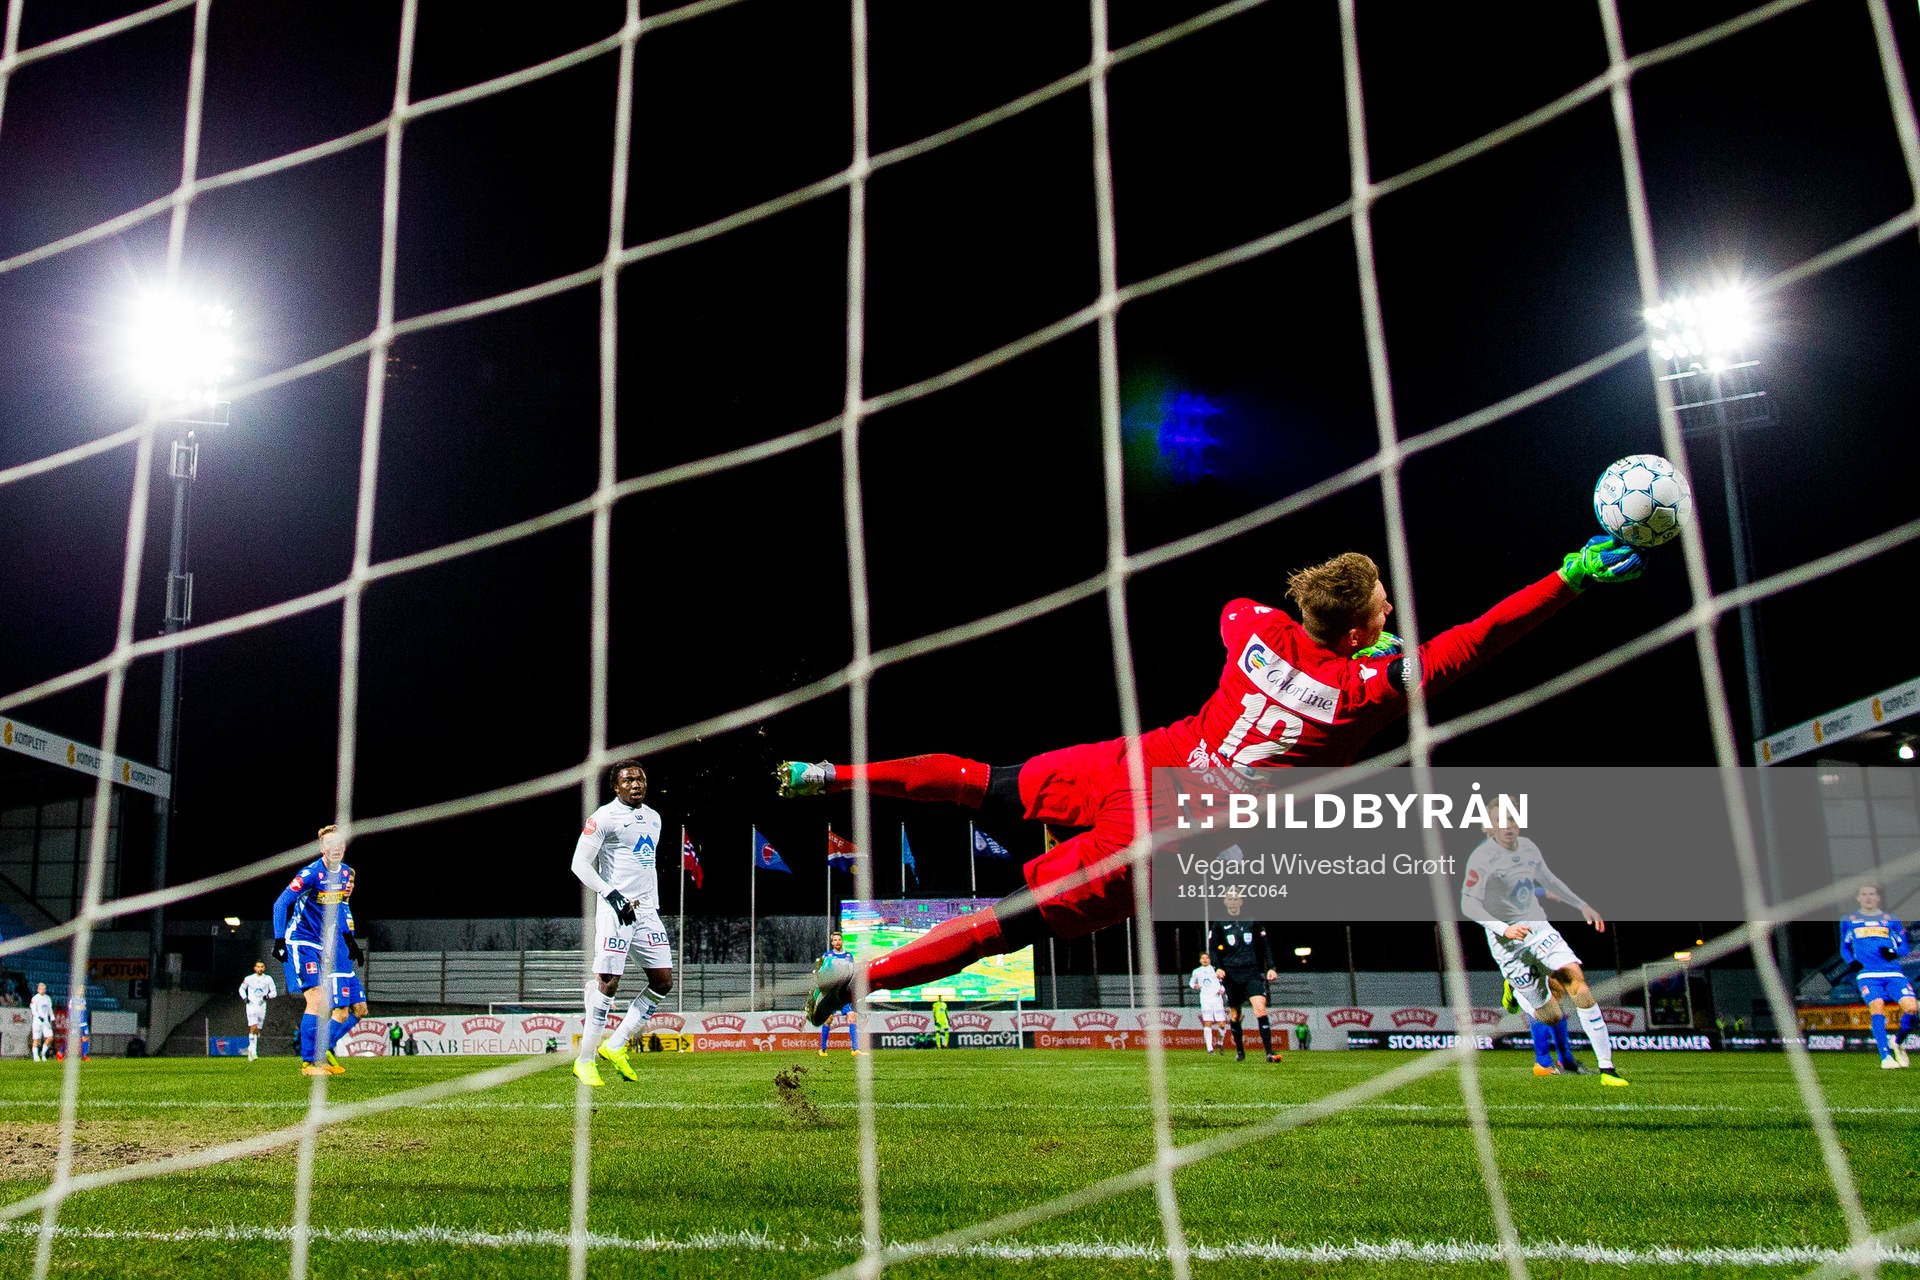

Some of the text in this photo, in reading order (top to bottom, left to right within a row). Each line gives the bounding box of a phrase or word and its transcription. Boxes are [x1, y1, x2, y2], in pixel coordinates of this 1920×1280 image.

[14, 730, 48, 752] KOMPLETT
[1217, 692, 1304, 781] 12
[608, 937, 628, 950] BD
[465, 1016, 502, 1032] MENY
[524, 1015, 562, 1031] MENY
[647, 1014, 684, 1029] MENY
[705, 1014, 743, 1029] MENY
[765, 1014, 803, 1030] MENY
[888, 1013, 927, 1029] MENY
[952, 1013, 990, 1029] MENY
[1076, 1011, 1116, 1027] MENY
[1329, 1008, 1371, 1025] MENY
[1394, 1008, 1436, 1025] MENY
[405, 1018, 443, 1034] MENY
[462, 1039, 543, 1053] EIKELAND
[708, 1038, 746, 1049] Fjordkraft
[782, 1038, 819, 1048] Elektrisk
